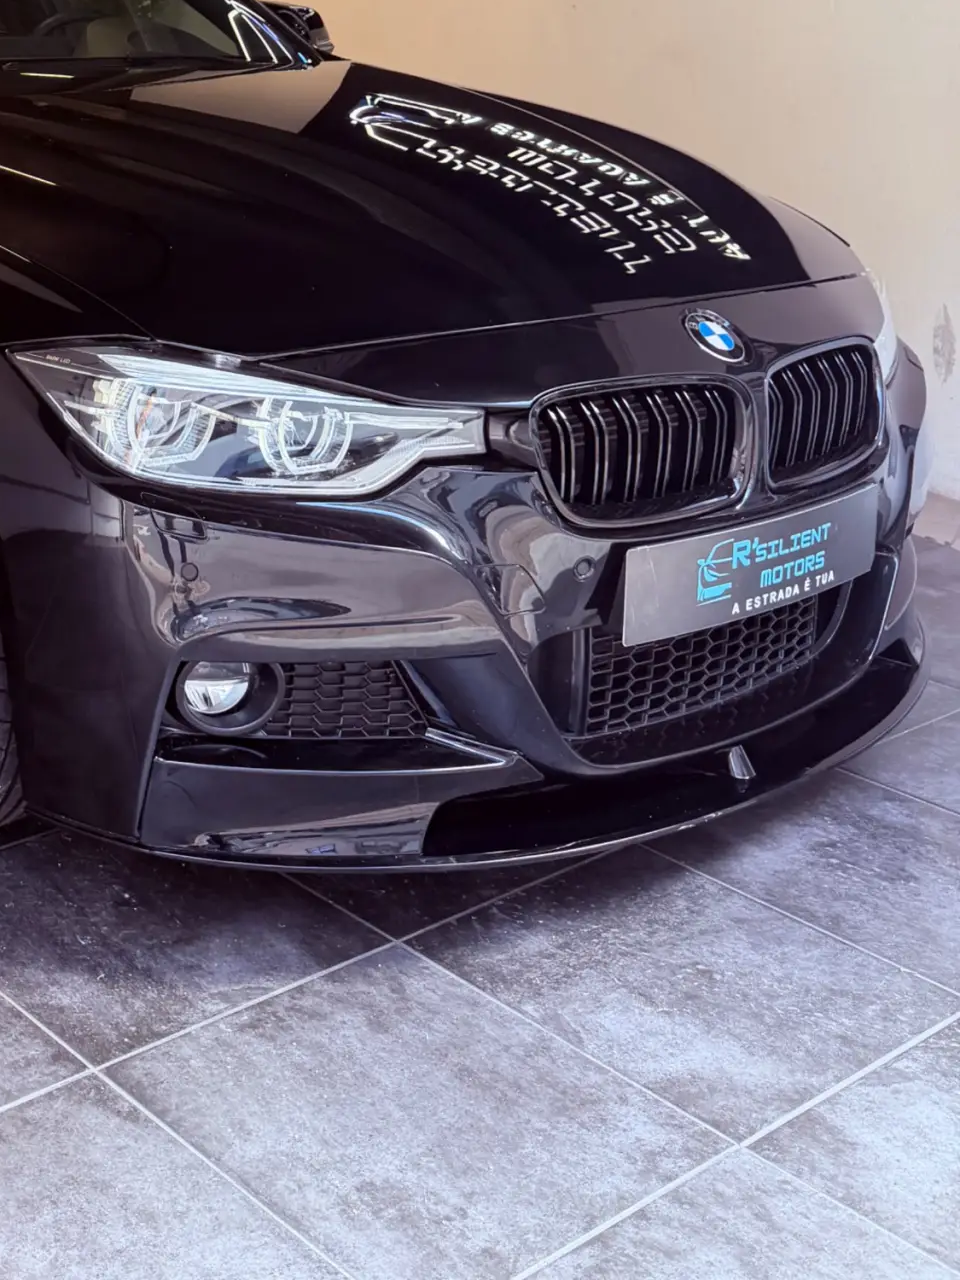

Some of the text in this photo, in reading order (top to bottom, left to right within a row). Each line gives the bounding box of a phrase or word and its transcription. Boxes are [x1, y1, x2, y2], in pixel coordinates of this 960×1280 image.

[731, 523, 832, 569] R'SILIENT
[759, 550, 826, 588] MOTORS
[731, 602, 740, 615] A
[745, 583, 800, 611] ESTRADA
[815, 570, 835, 588] TUA
